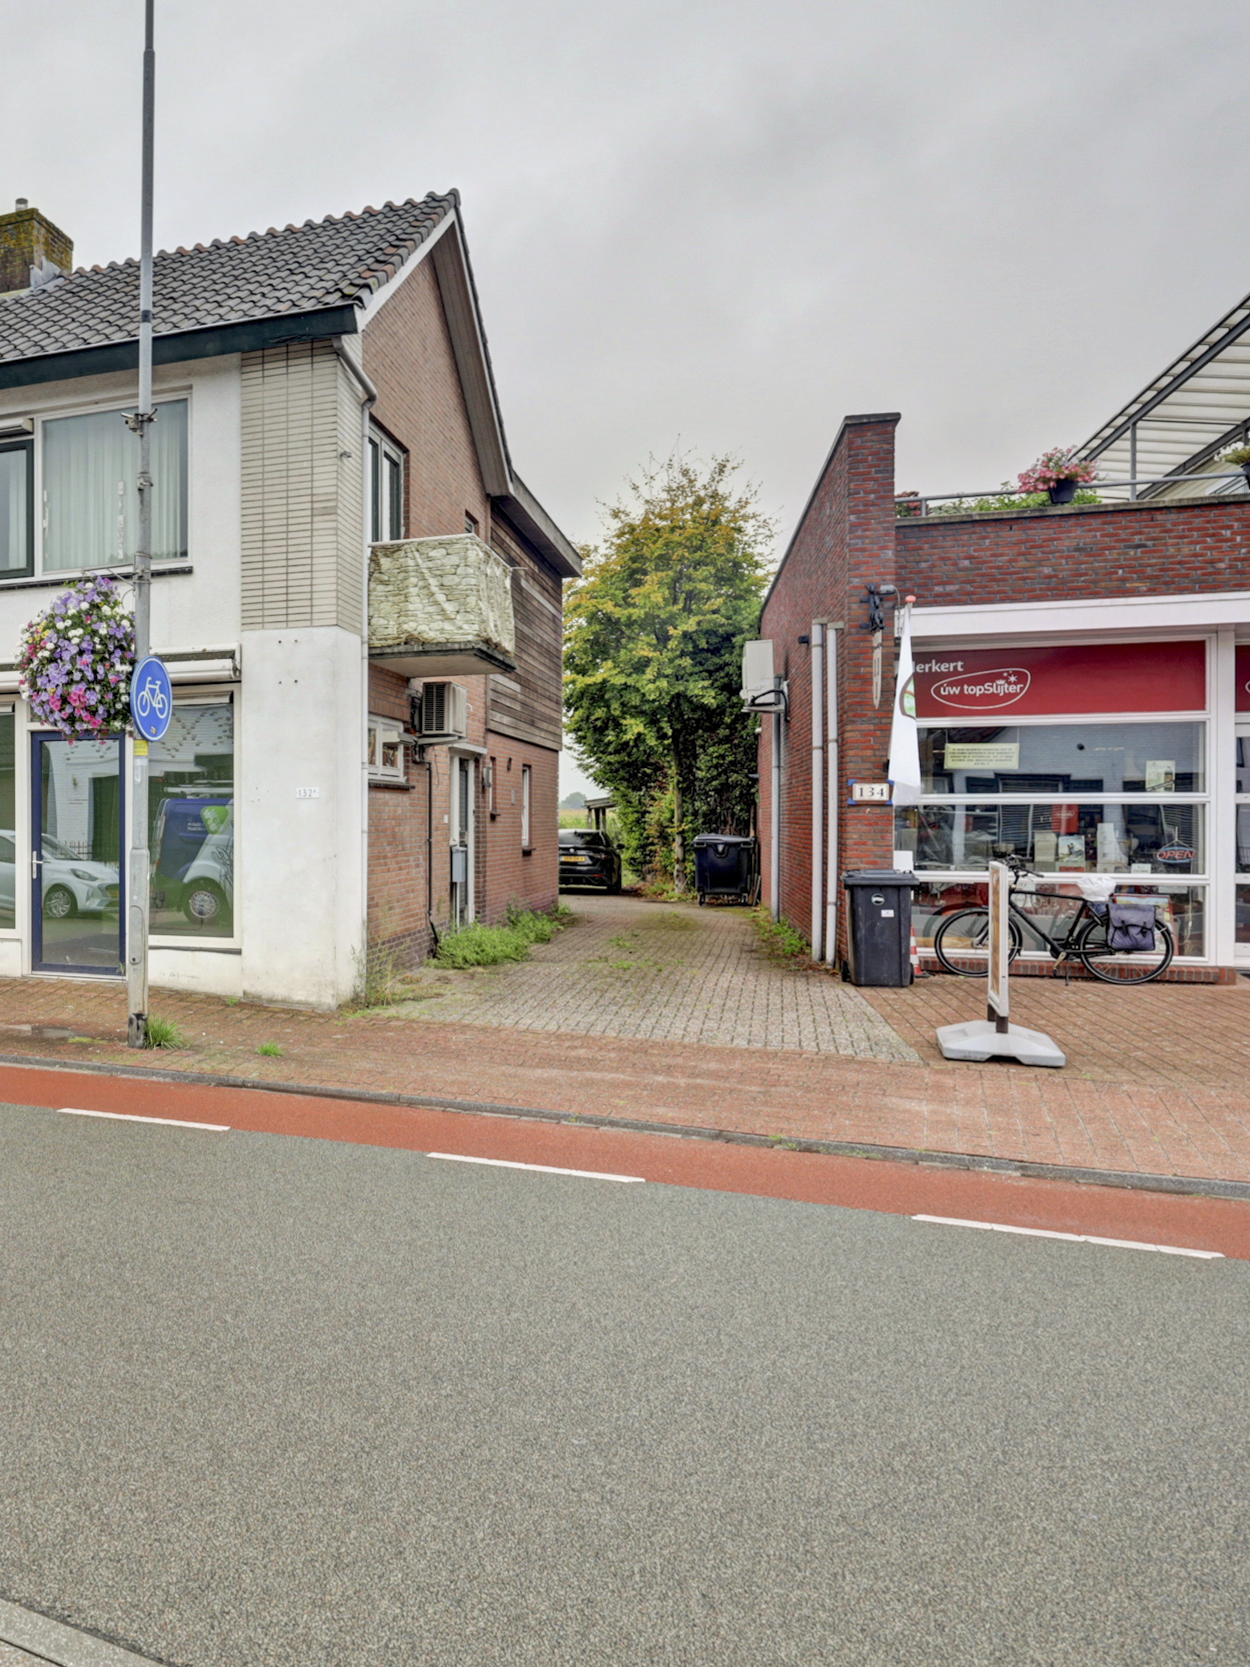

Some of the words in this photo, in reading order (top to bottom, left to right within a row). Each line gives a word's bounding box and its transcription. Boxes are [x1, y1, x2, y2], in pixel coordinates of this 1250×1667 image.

[912, 659, 964, 673] erkert
[940, 683, 961, 695] úw
[963, 681, 1024, 697] topSlijter
[859, 787, 885, 797] 134
[1156, 850, 1196, 860] OPEN
